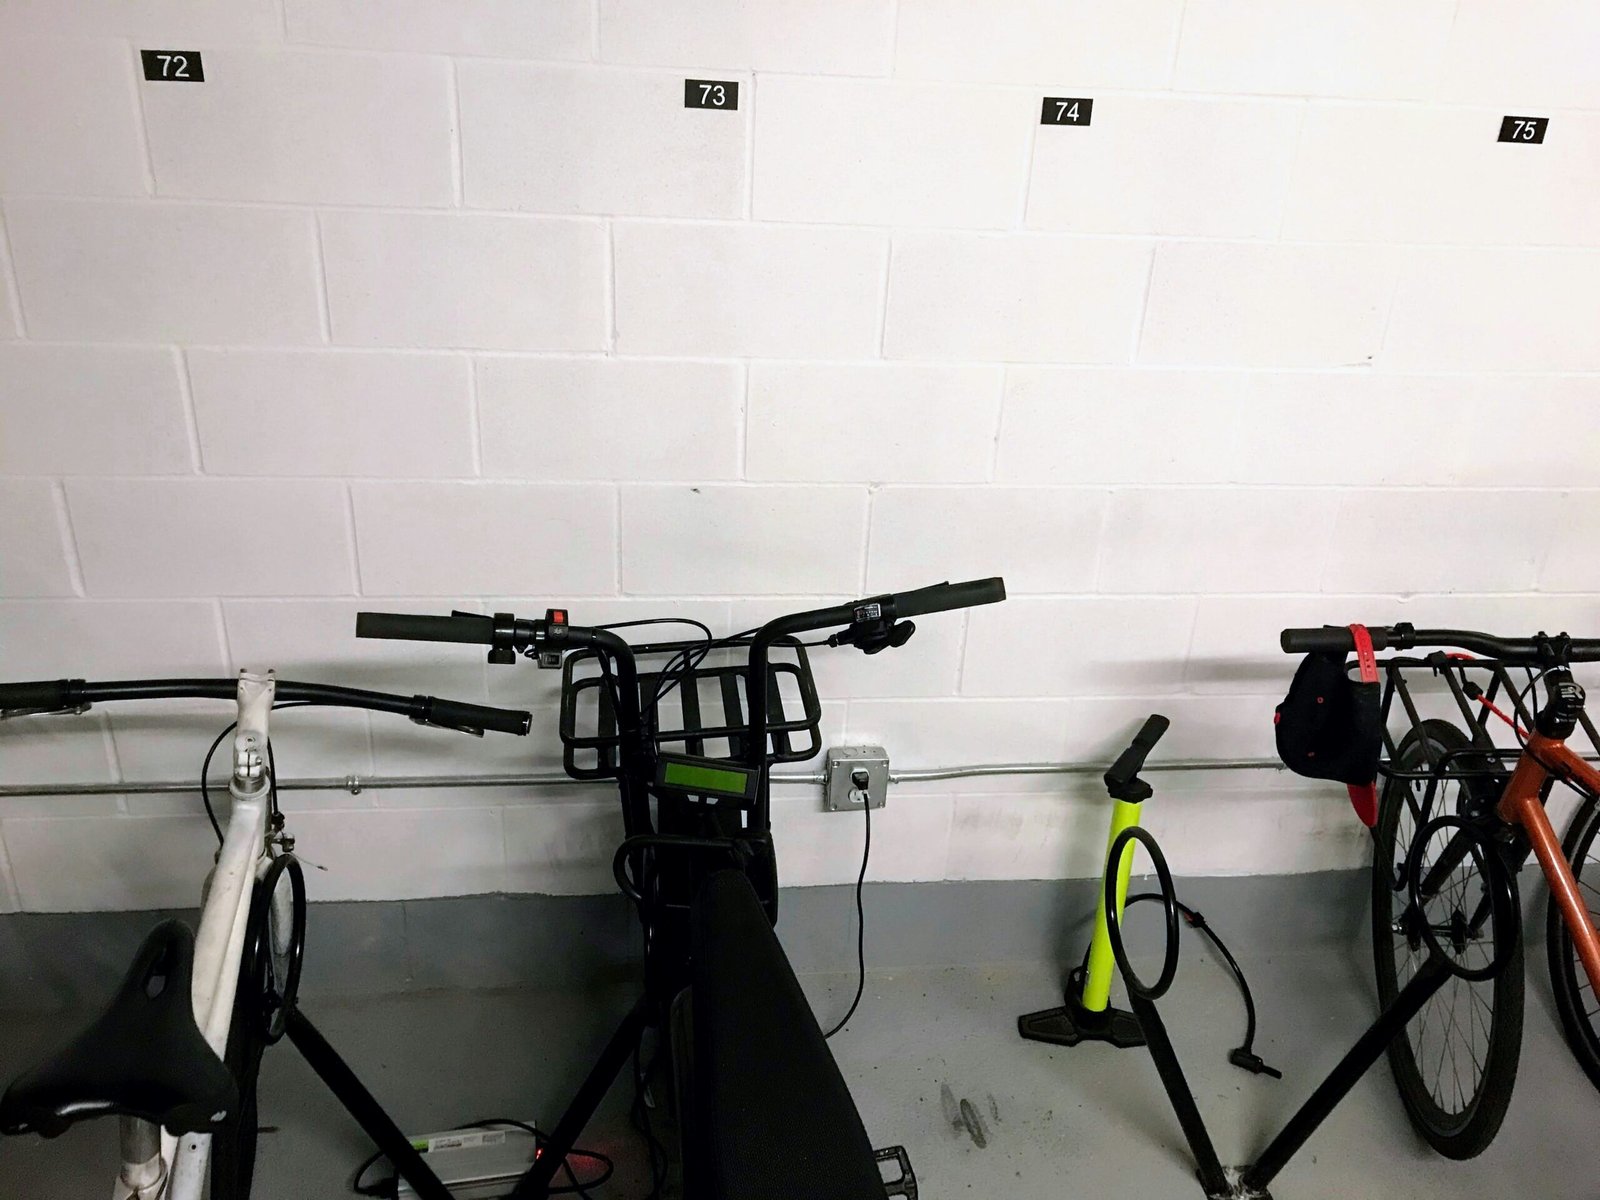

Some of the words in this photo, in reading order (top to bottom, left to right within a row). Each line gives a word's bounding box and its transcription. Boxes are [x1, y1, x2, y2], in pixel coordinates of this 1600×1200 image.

[156, 55, 190, 78] 72
[699, 84, 726, 106] 73
[1055, 101, 1080, 122] 74
[1512, 120, 1537, 140] 75
